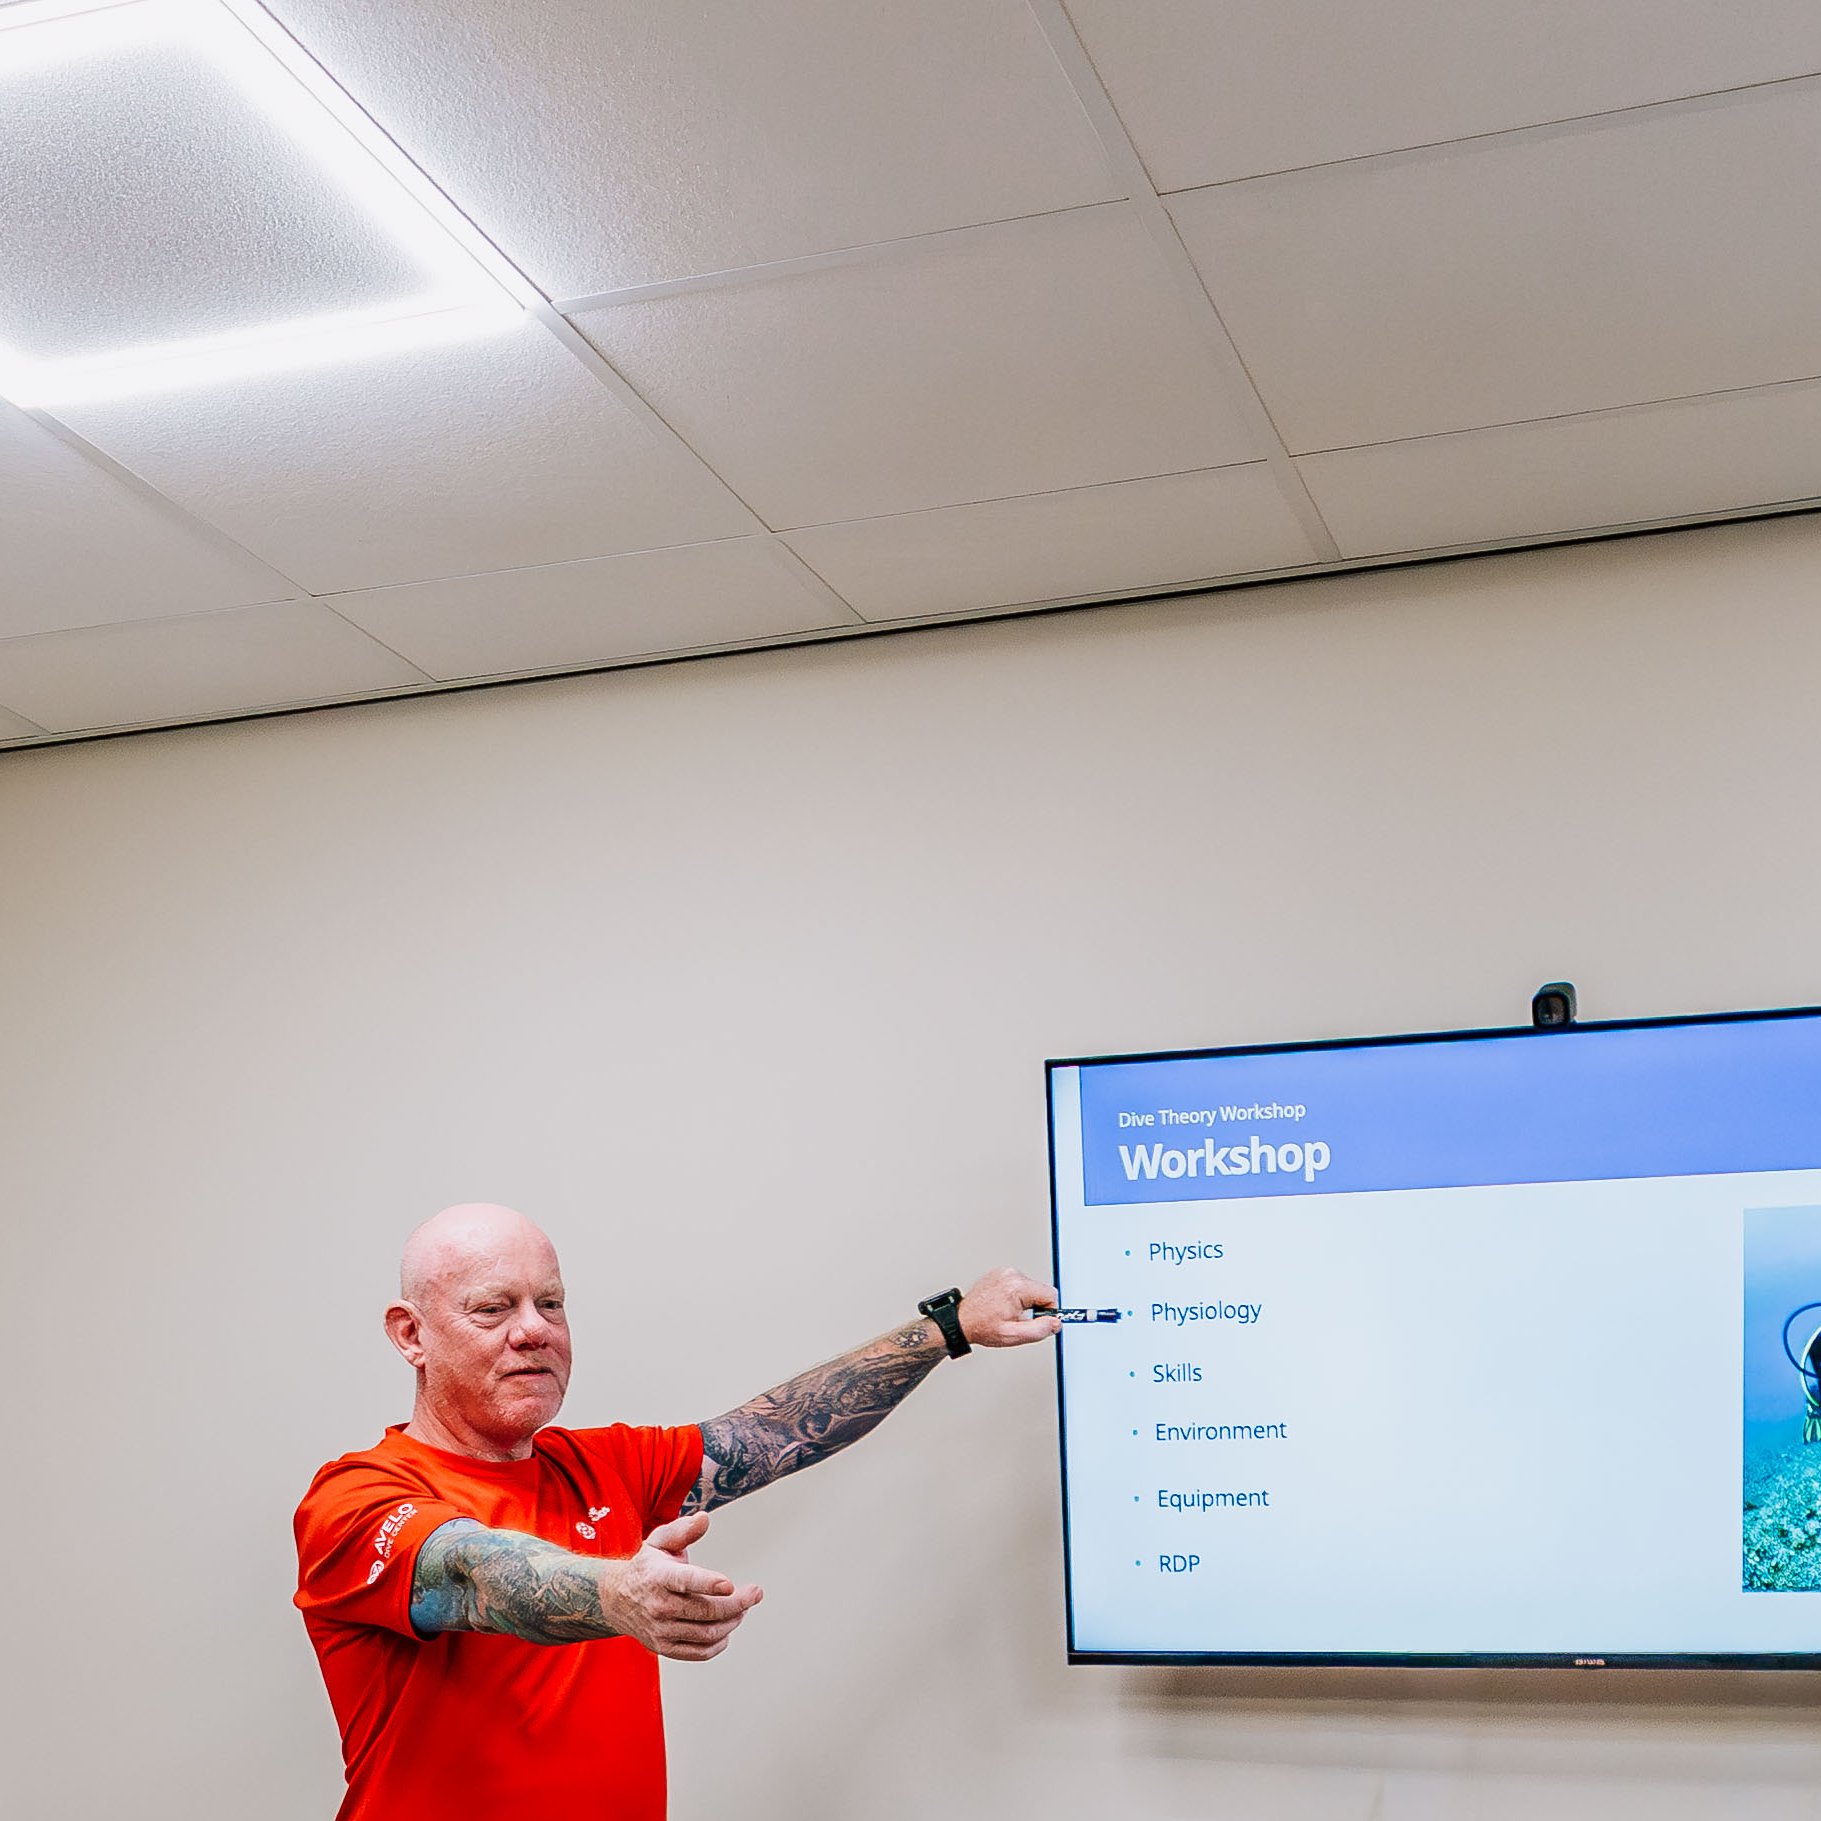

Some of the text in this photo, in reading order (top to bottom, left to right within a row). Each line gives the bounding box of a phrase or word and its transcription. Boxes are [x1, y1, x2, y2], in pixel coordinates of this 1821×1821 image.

[1118, 1102, 1306, 1128] Dive Theory Workshop
[1117, 1135, 1331, 1183] Workshop
[1149, 1240, 1224, 1266] Physics
[1151, 1300, 1262, 1327] Physiology
[1153, 1362, 1203, 1383] Skills
[1155, 1422, 1288, 1441] Environment
[1158, 1489, 1270, 1513] Equipment
[374, 1503, 413, 1555] AVELO
[384, 1509, 418, 1558] DIVE CENTER
[1159, 1554, 1200, 1573] RDP
